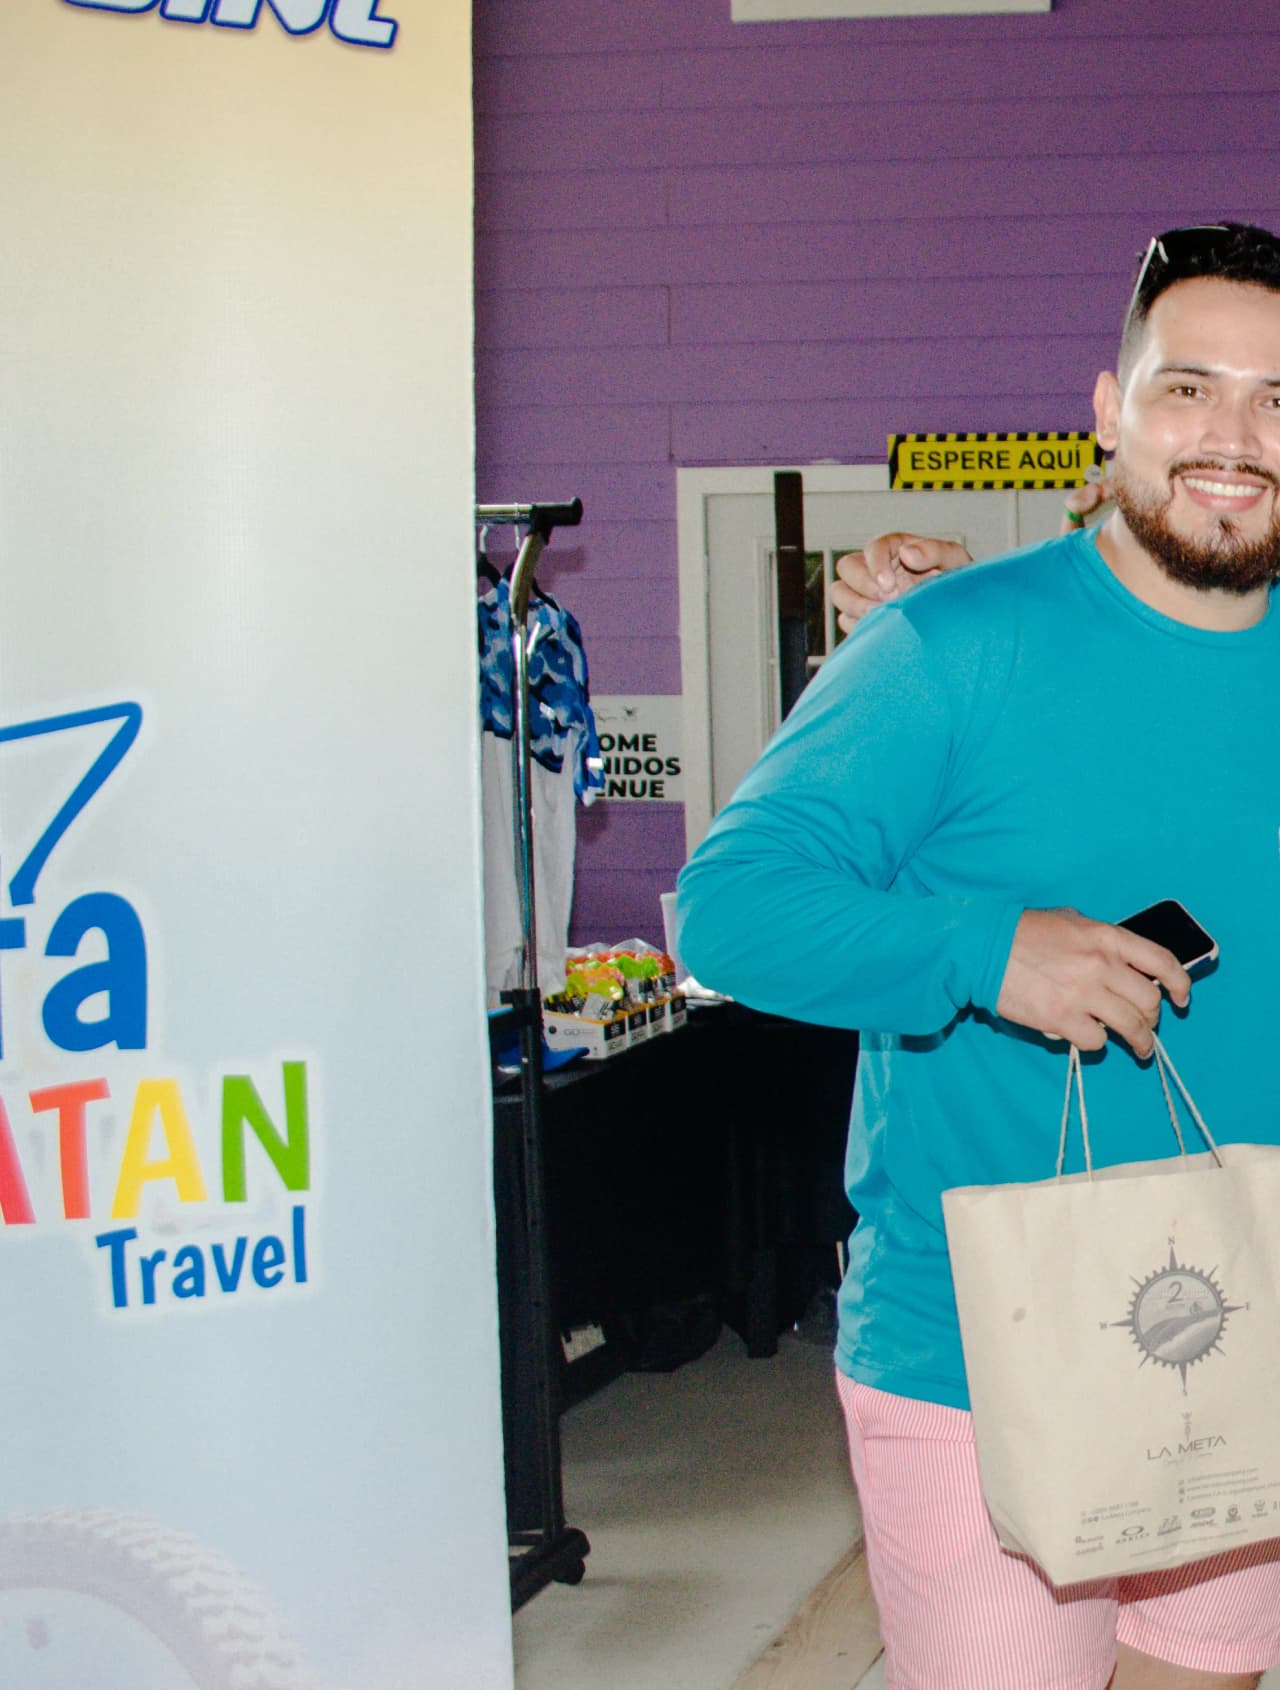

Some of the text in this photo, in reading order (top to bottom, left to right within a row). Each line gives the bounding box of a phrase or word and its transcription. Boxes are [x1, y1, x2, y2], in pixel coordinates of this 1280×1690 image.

[910, 444, 1081, 471] ESPERE AQUÍ
[595, 779, 665, 798] NUE
[95, 1205, 308, 1309] Travel
[1167, 1281, 1184, 1304] 2
[1146, 1446, 1172, 1461] LA
[1177, 1435, 1227, 1455] META
